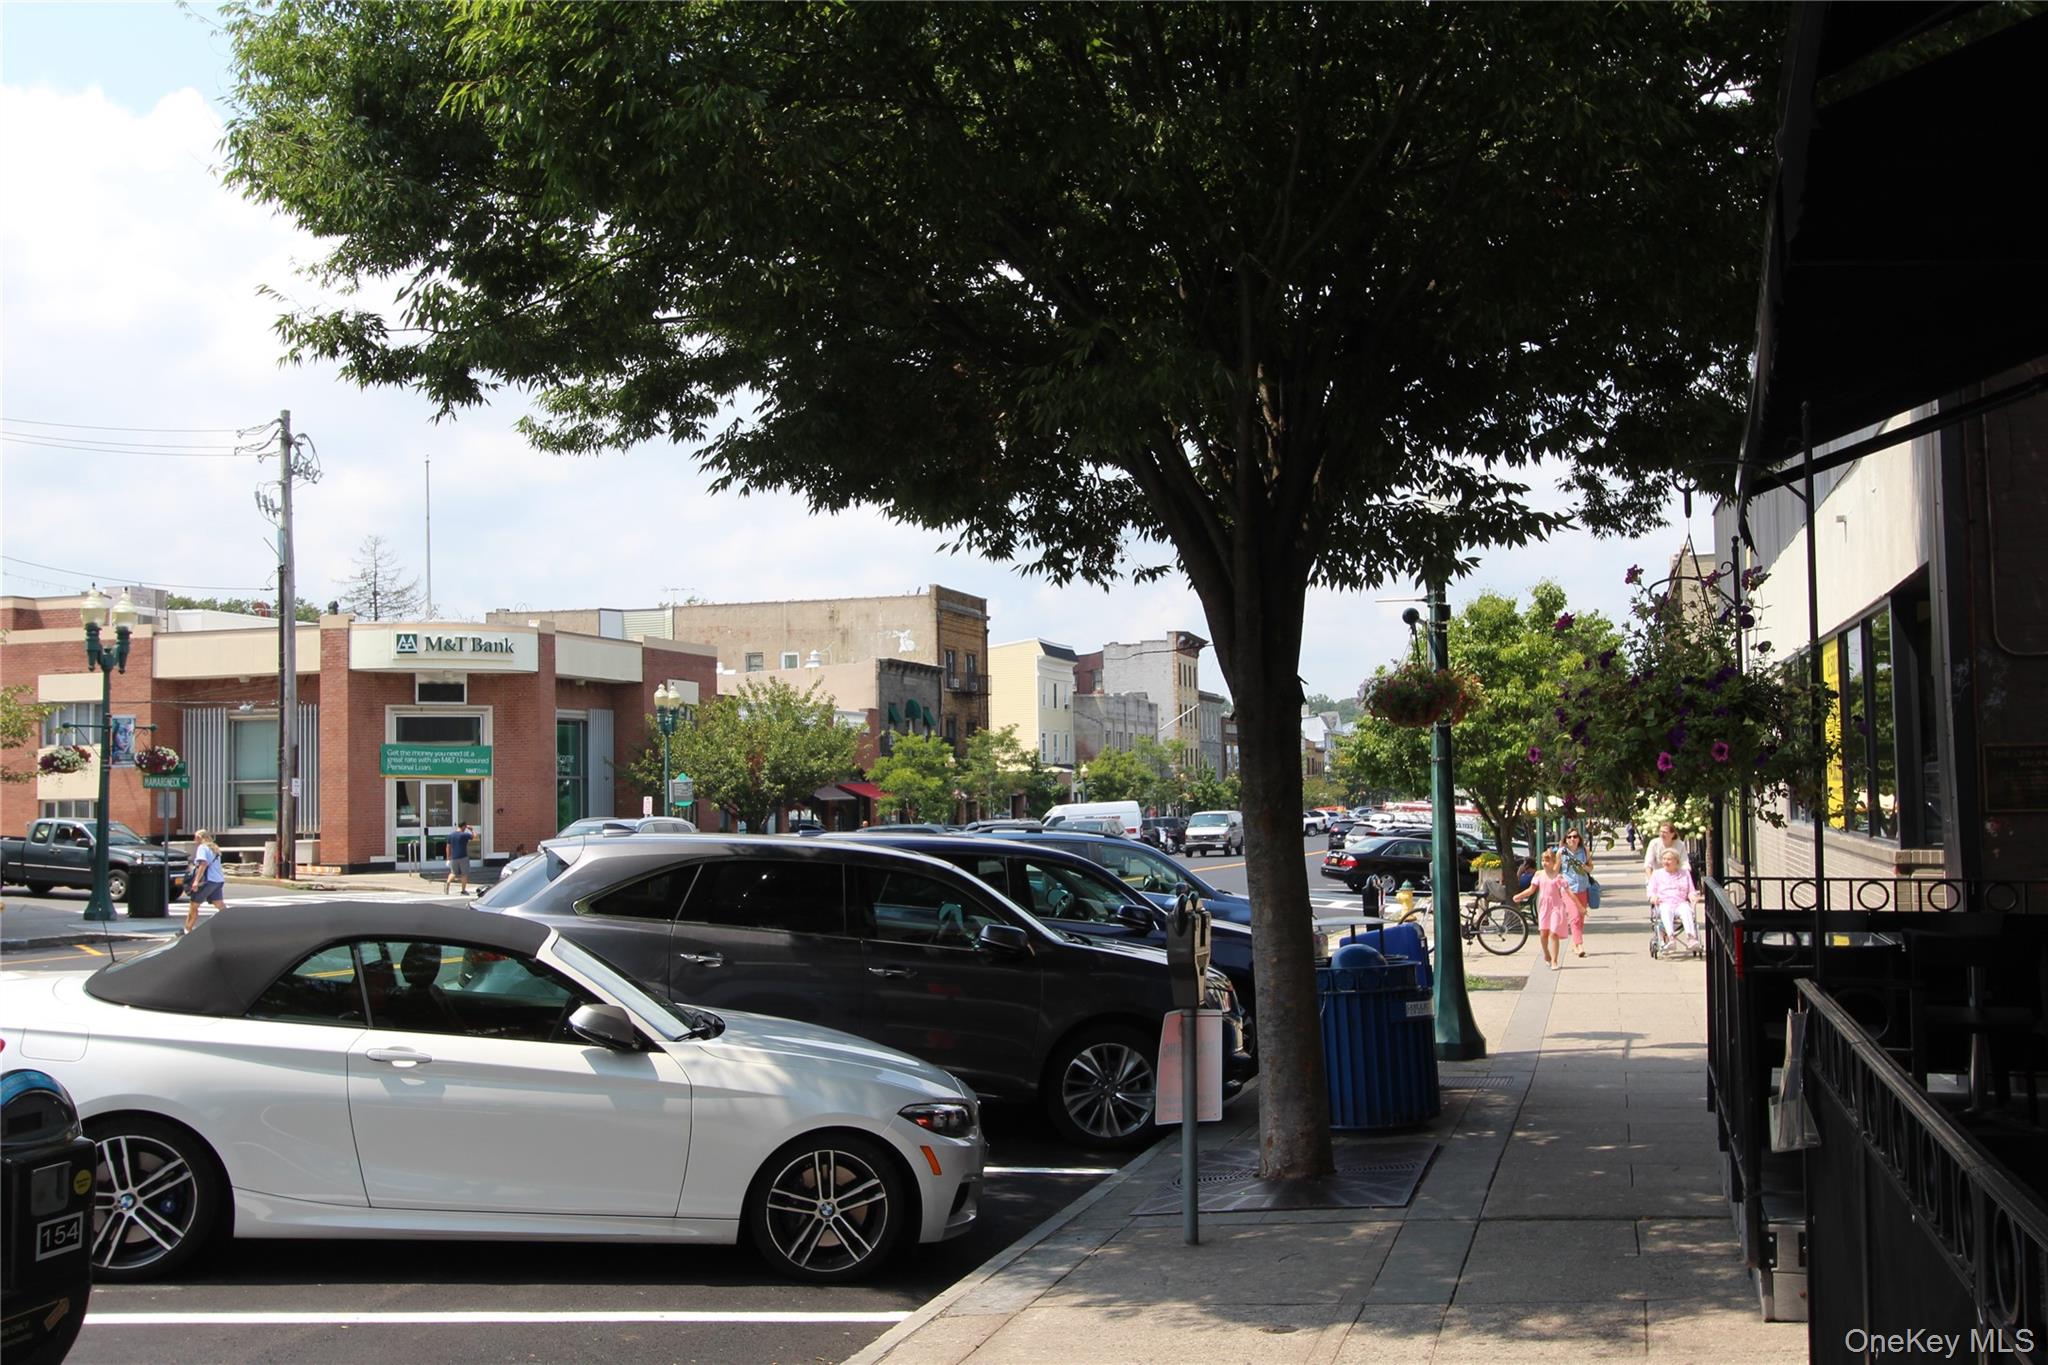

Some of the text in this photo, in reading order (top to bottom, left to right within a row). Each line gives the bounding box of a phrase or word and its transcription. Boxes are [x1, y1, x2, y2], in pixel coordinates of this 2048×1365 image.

[425, 636, 514, 654] M&T Bank
[386, 749, 399, 757] Get
[386, 757, 401, 765] great
[144, 776, 181, 787] MAMARONECK
[42, 1221, 79, 1248] 154
